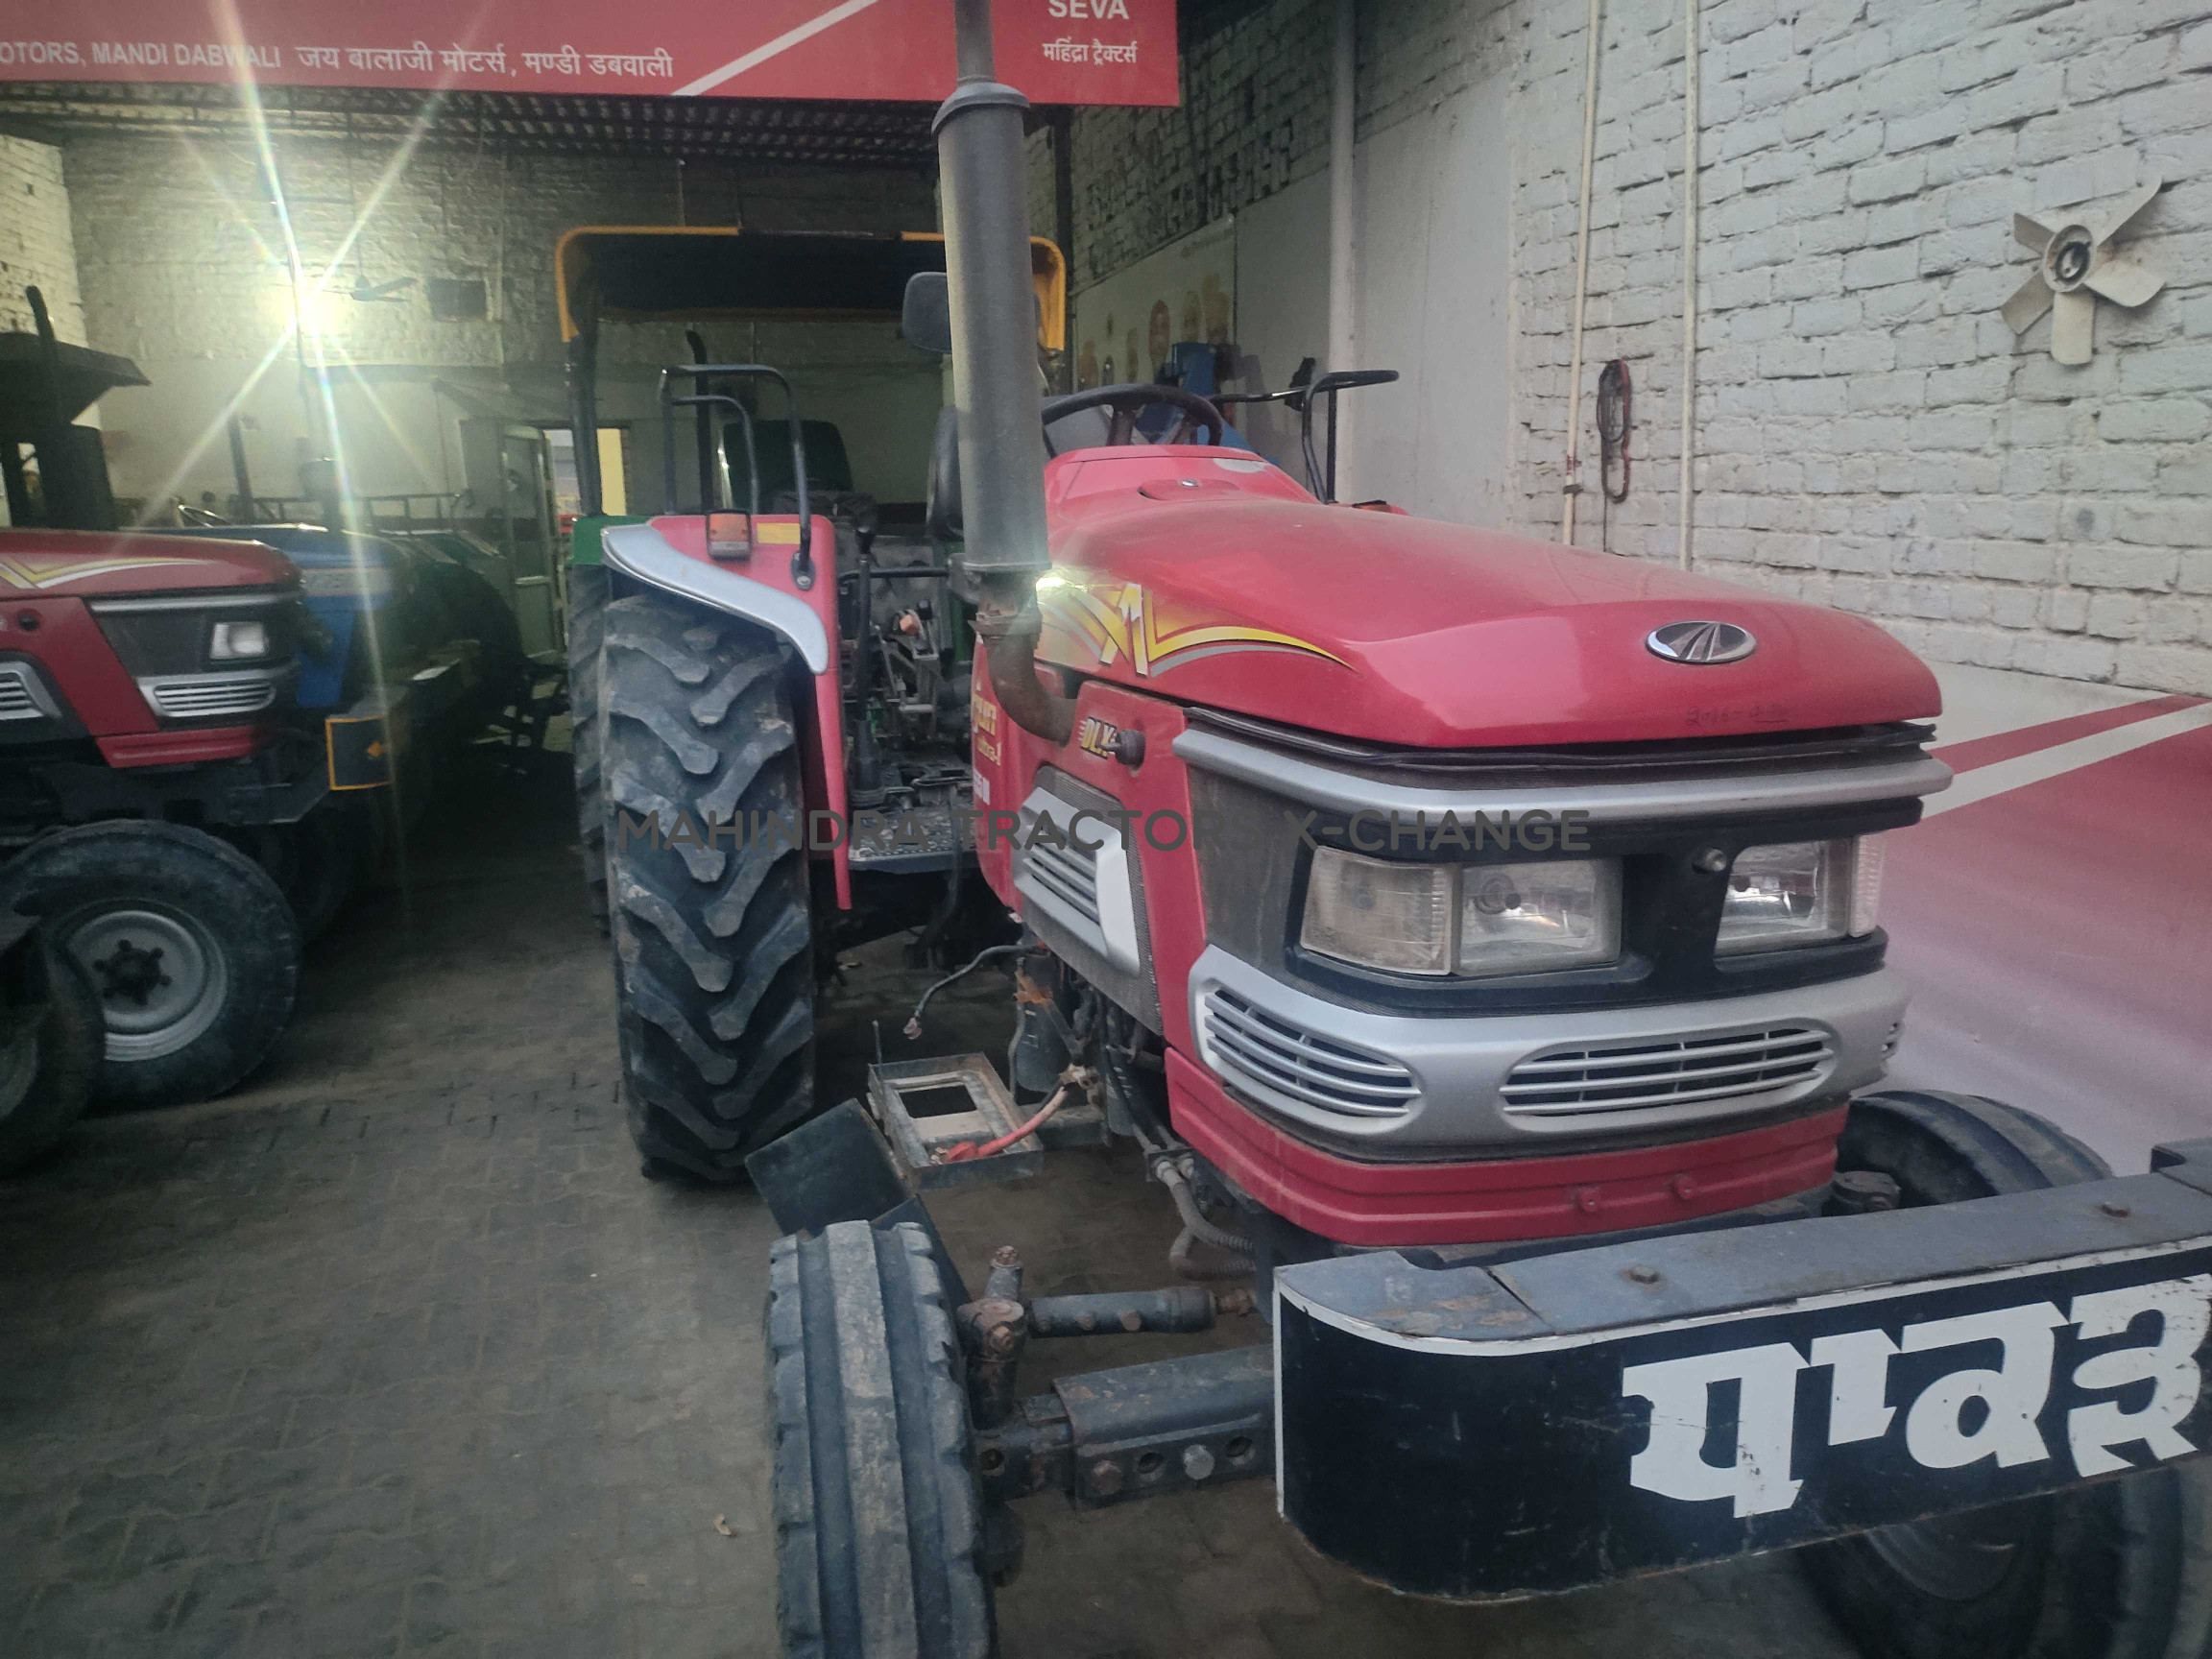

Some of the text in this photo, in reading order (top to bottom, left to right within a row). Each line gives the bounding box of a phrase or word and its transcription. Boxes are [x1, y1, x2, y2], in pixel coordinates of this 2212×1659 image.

[1048, 0, 1129, 19] SEVA
[92, 42, 168, 65] MANDI
[176, 43, 281, 68] DABWALI
[293, 41, 674, 78] जय बालाजी मोटर्स, मण्डी डबवाली
[1042, 36, 1138, 65] महिंद्रा ट्रैक्टर्स
